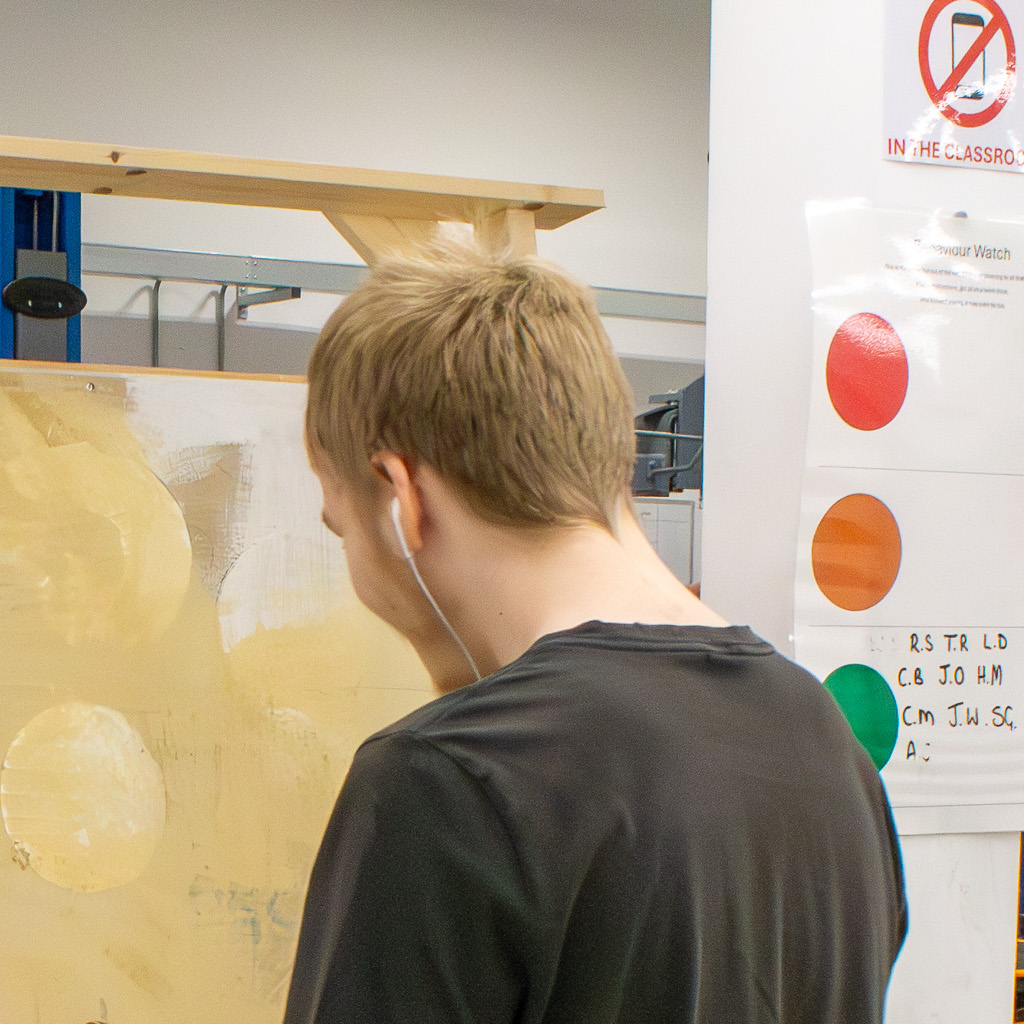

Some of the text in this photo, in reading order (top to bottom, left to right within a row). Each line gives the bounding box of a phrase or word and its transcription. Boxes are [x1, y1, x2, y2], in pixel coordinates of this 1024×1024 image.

[888, 137, 906, 156] IN
[973, 244, 1011, 261] Watch
[897, 667, 924, 687] C.B
